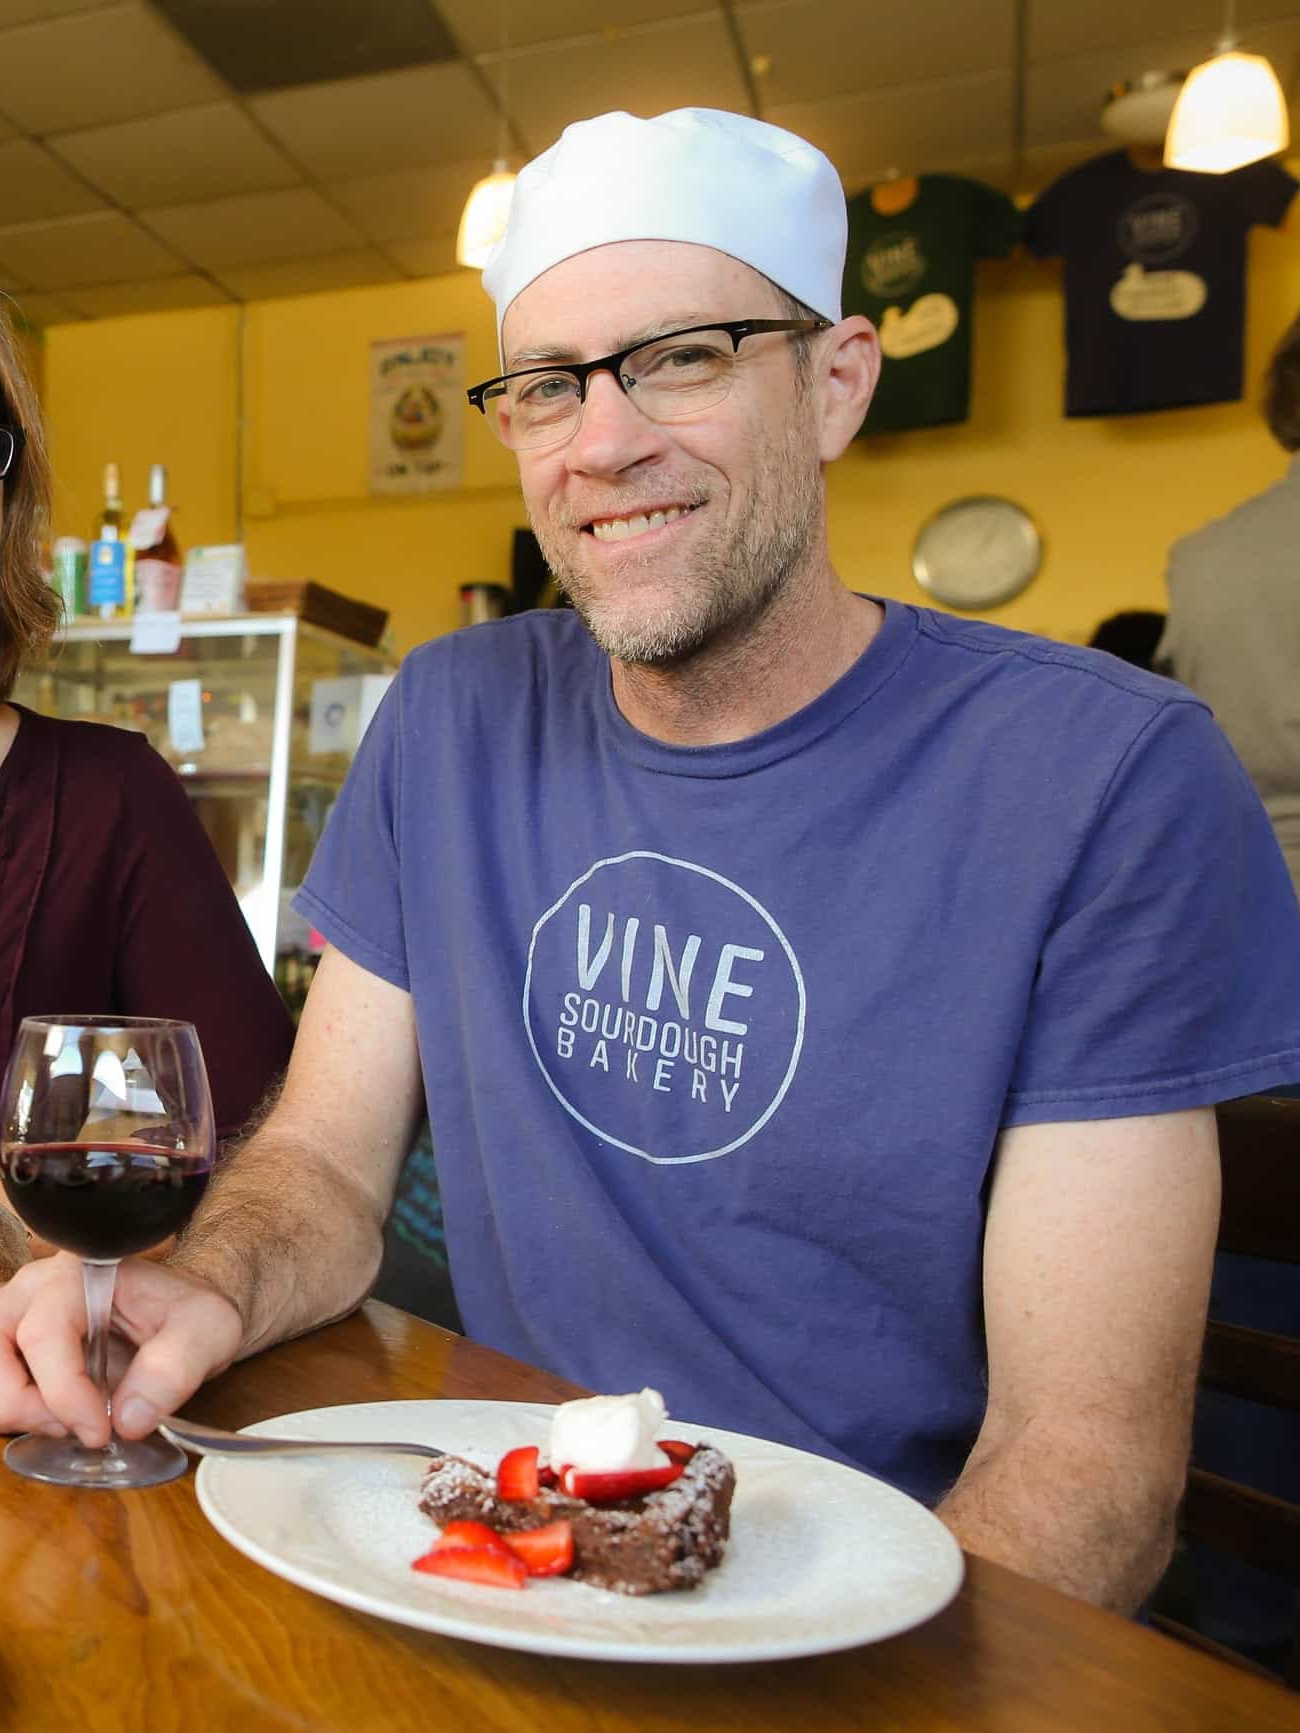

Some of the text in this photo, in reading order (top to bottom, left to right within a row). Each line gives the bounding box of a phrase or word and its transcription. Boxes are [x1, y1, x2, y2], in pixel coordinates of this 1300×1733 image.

[576, 903, 765, 1037] VINE
[556, 1026, 740, 1113] BAKERY
[559, 992, 744, 1079] SOURDOUGH
